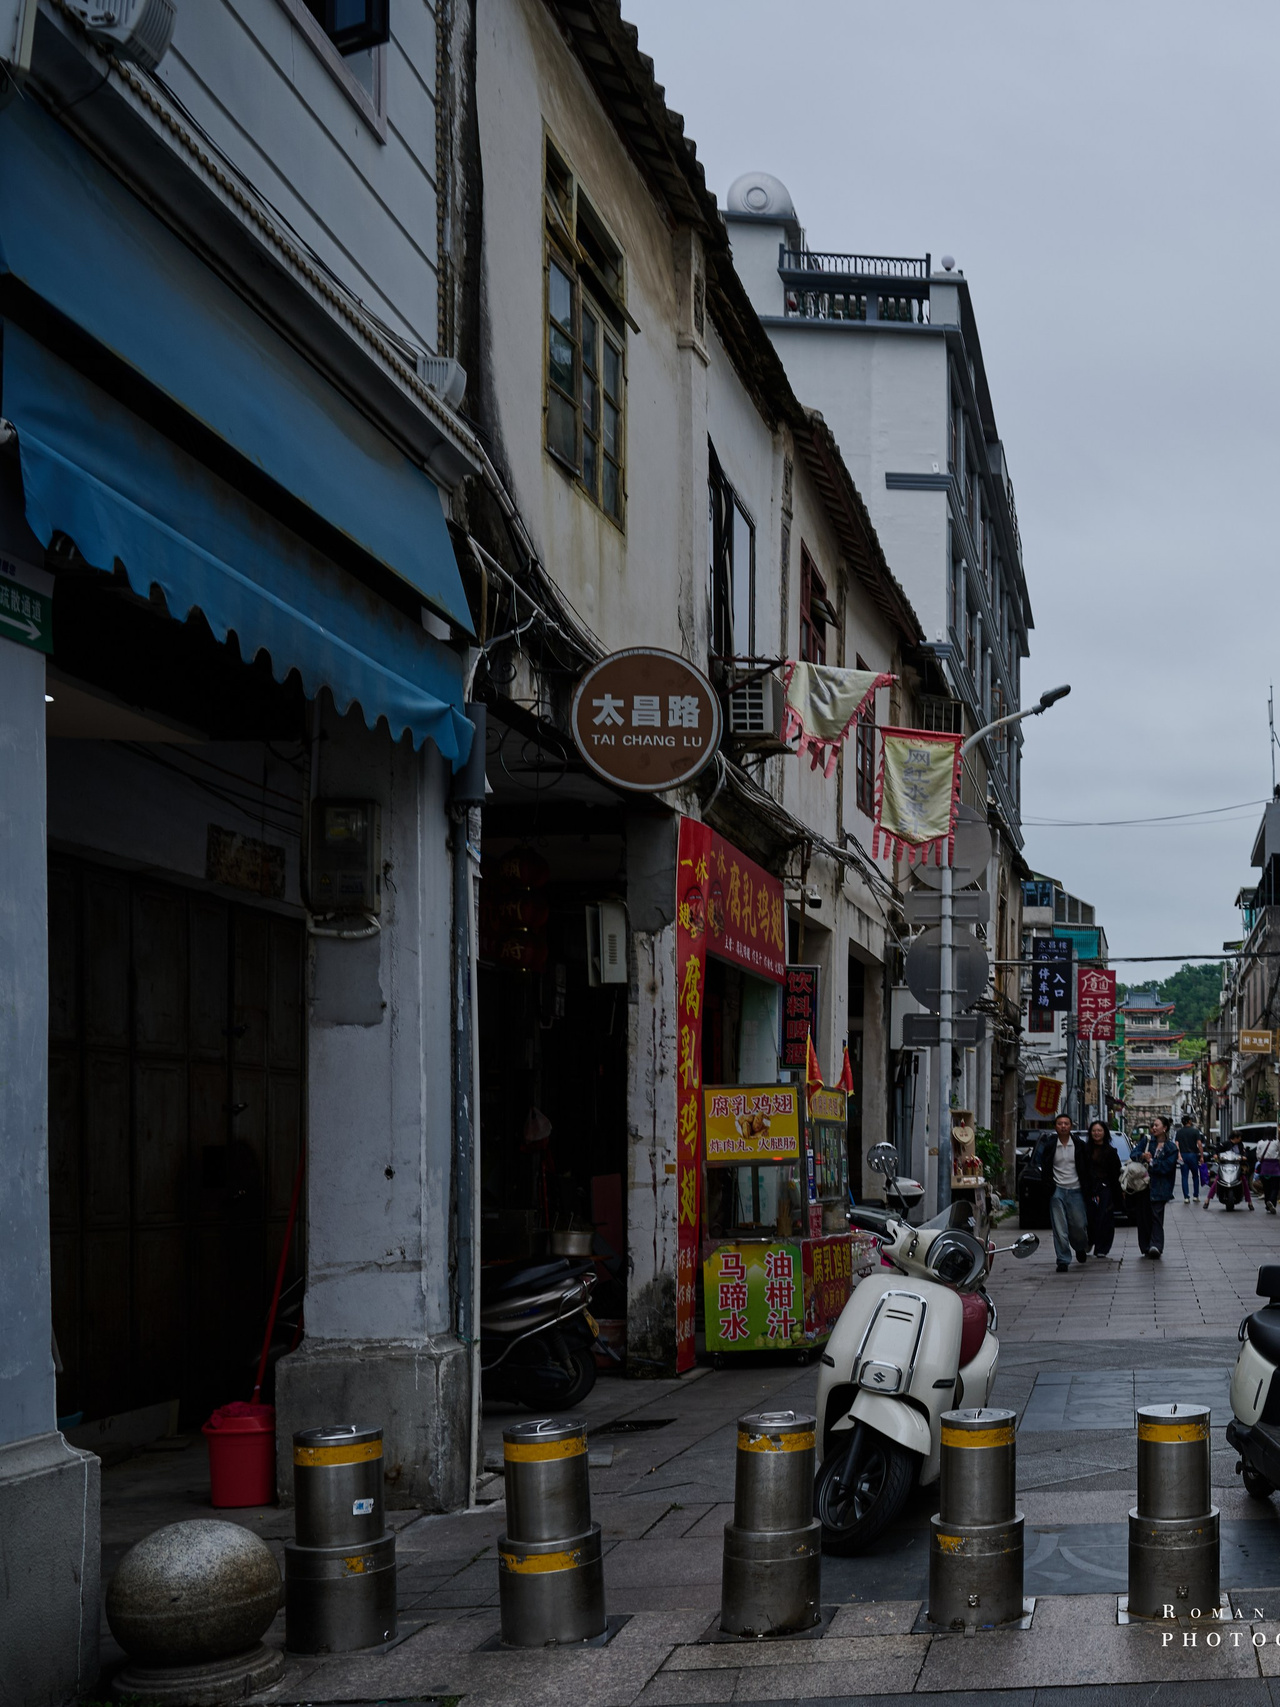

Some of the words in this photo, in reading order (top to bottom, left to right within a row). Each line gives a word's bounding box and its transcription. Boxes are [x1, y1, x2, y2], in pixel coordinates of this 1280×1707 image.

[591, 734, 615, 746] TAI
[622, 734, 676, 748] CHANG
[683, 736, 703, 748] LU
[592, 693, 701, 729] 太昌路
[726, 860, 784, 953] 腐乳鸡翅
[786, 971, 812, 1065] 饮料啤酒
[680, 953, 701, 1228] 腐乳鸡翅
[709, 1094, 793, 1117] 腐乳鸡翅
[709, 1139, 753, 1153] 炸肉丸、
[758, 1137, 796, 1151] 火腿肠
[718, 1253, 750, 1341] 马蹄水
[764, 1250, 796, 1339] 油柑汁
